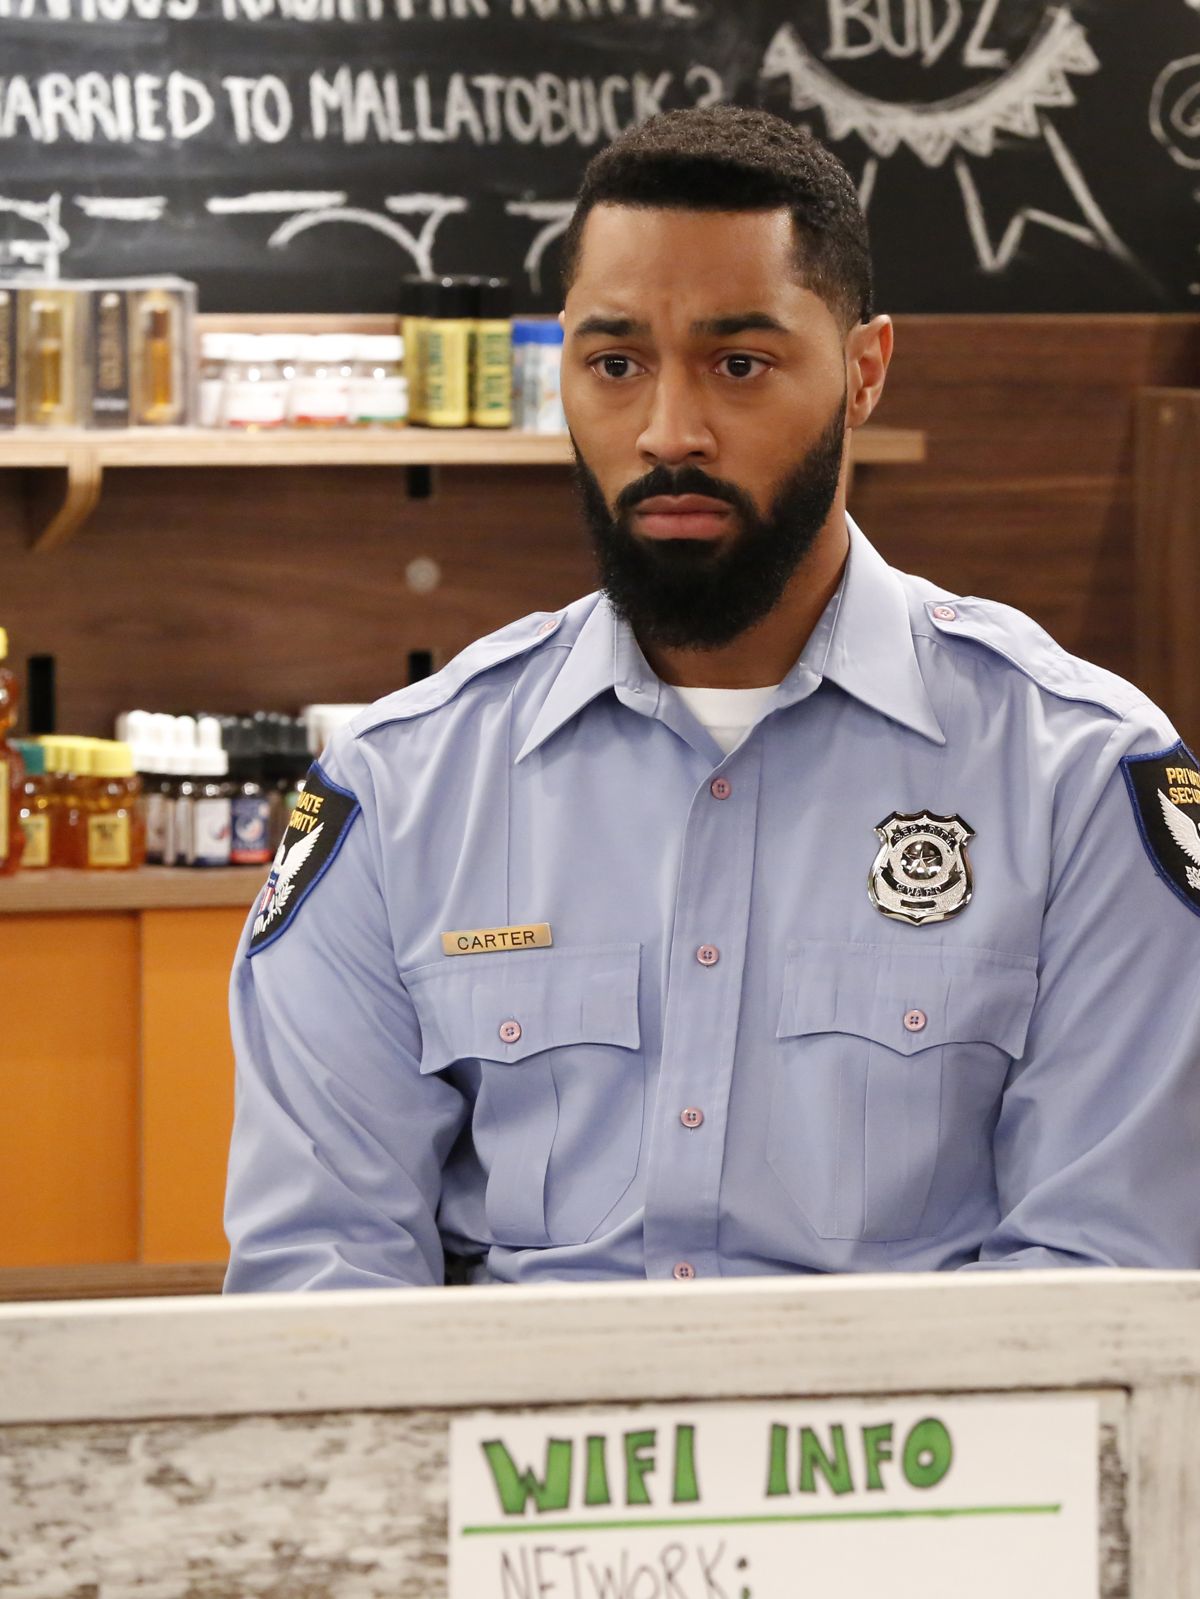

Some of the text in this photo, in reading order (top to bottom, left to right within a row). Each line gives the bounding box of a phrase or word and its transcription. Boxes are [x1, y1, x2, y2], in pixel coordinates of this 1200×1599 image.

[0, 70, 215, 143] ARRIED
[222, 74, 293, 143] TO
[457, 930, 536, 950] CARTER
[481, 1416, 954, 1516] WIFI INFO
